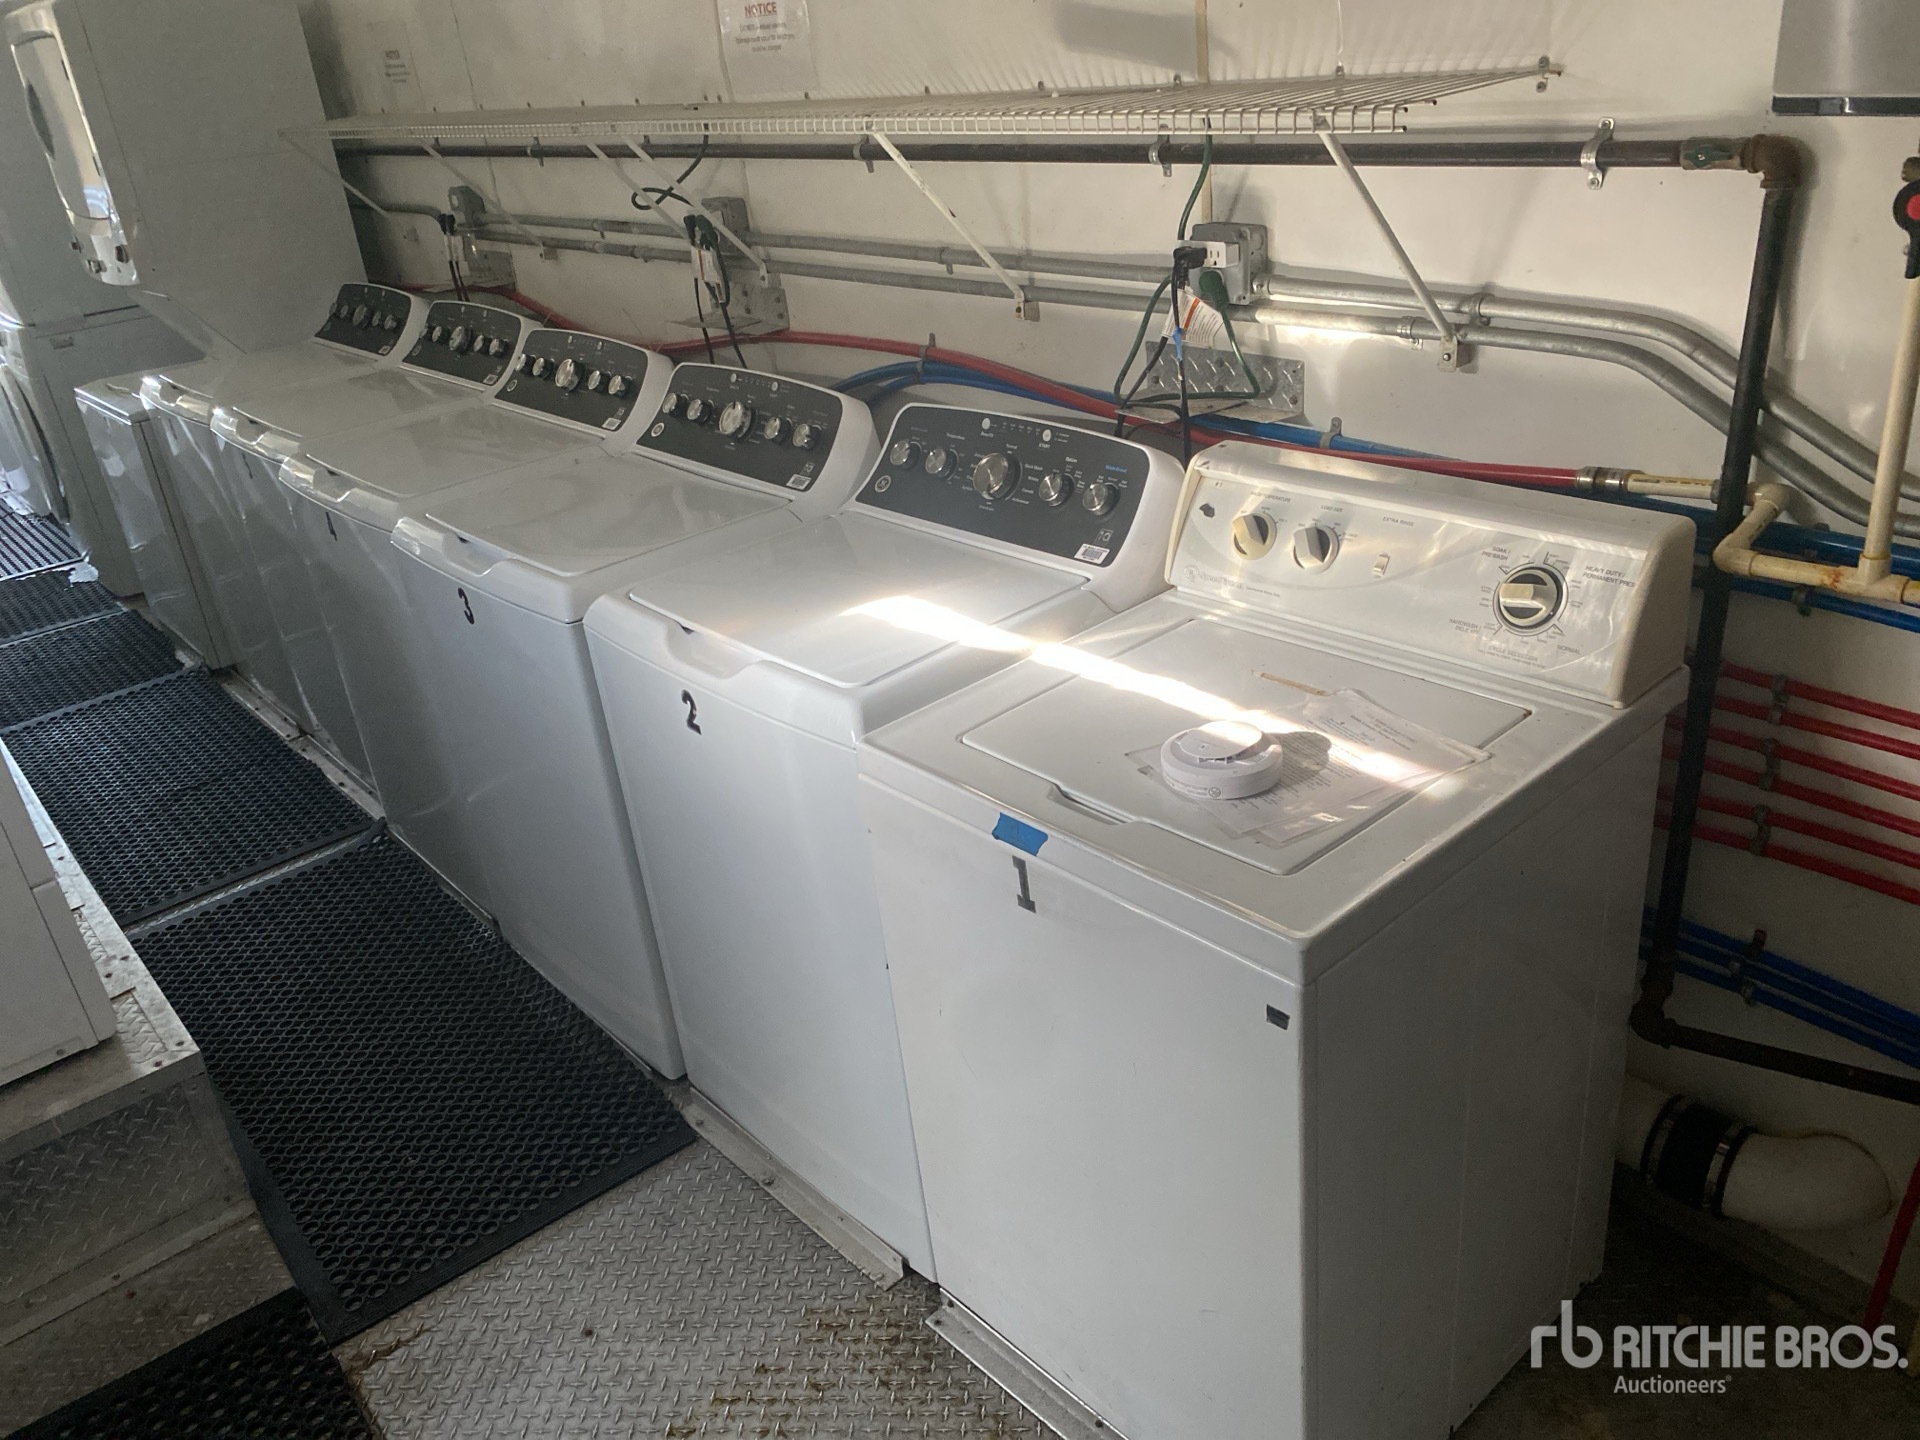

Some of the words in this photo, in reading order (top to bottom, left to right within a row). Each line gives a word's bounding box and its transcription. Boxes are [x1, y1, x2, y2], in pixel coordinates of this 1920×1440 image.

[744, 1, 778, 17] NOTICE
[1382, 516, 1399, 524] EXTRA
[1399, 518, 1416, 527] RINSE
[1481, 551, 1509, 561] PREWASH
[1582, 571, 1619, 584] PERMANENT
[1585, 565, 1605, 574] HEAVY
[1605, 569, 1622, 577] DUTY
[457, 587, 475, 626] 3
[680, 688, 702, 736] 2
[1011, 855, 1037, 914] 1
